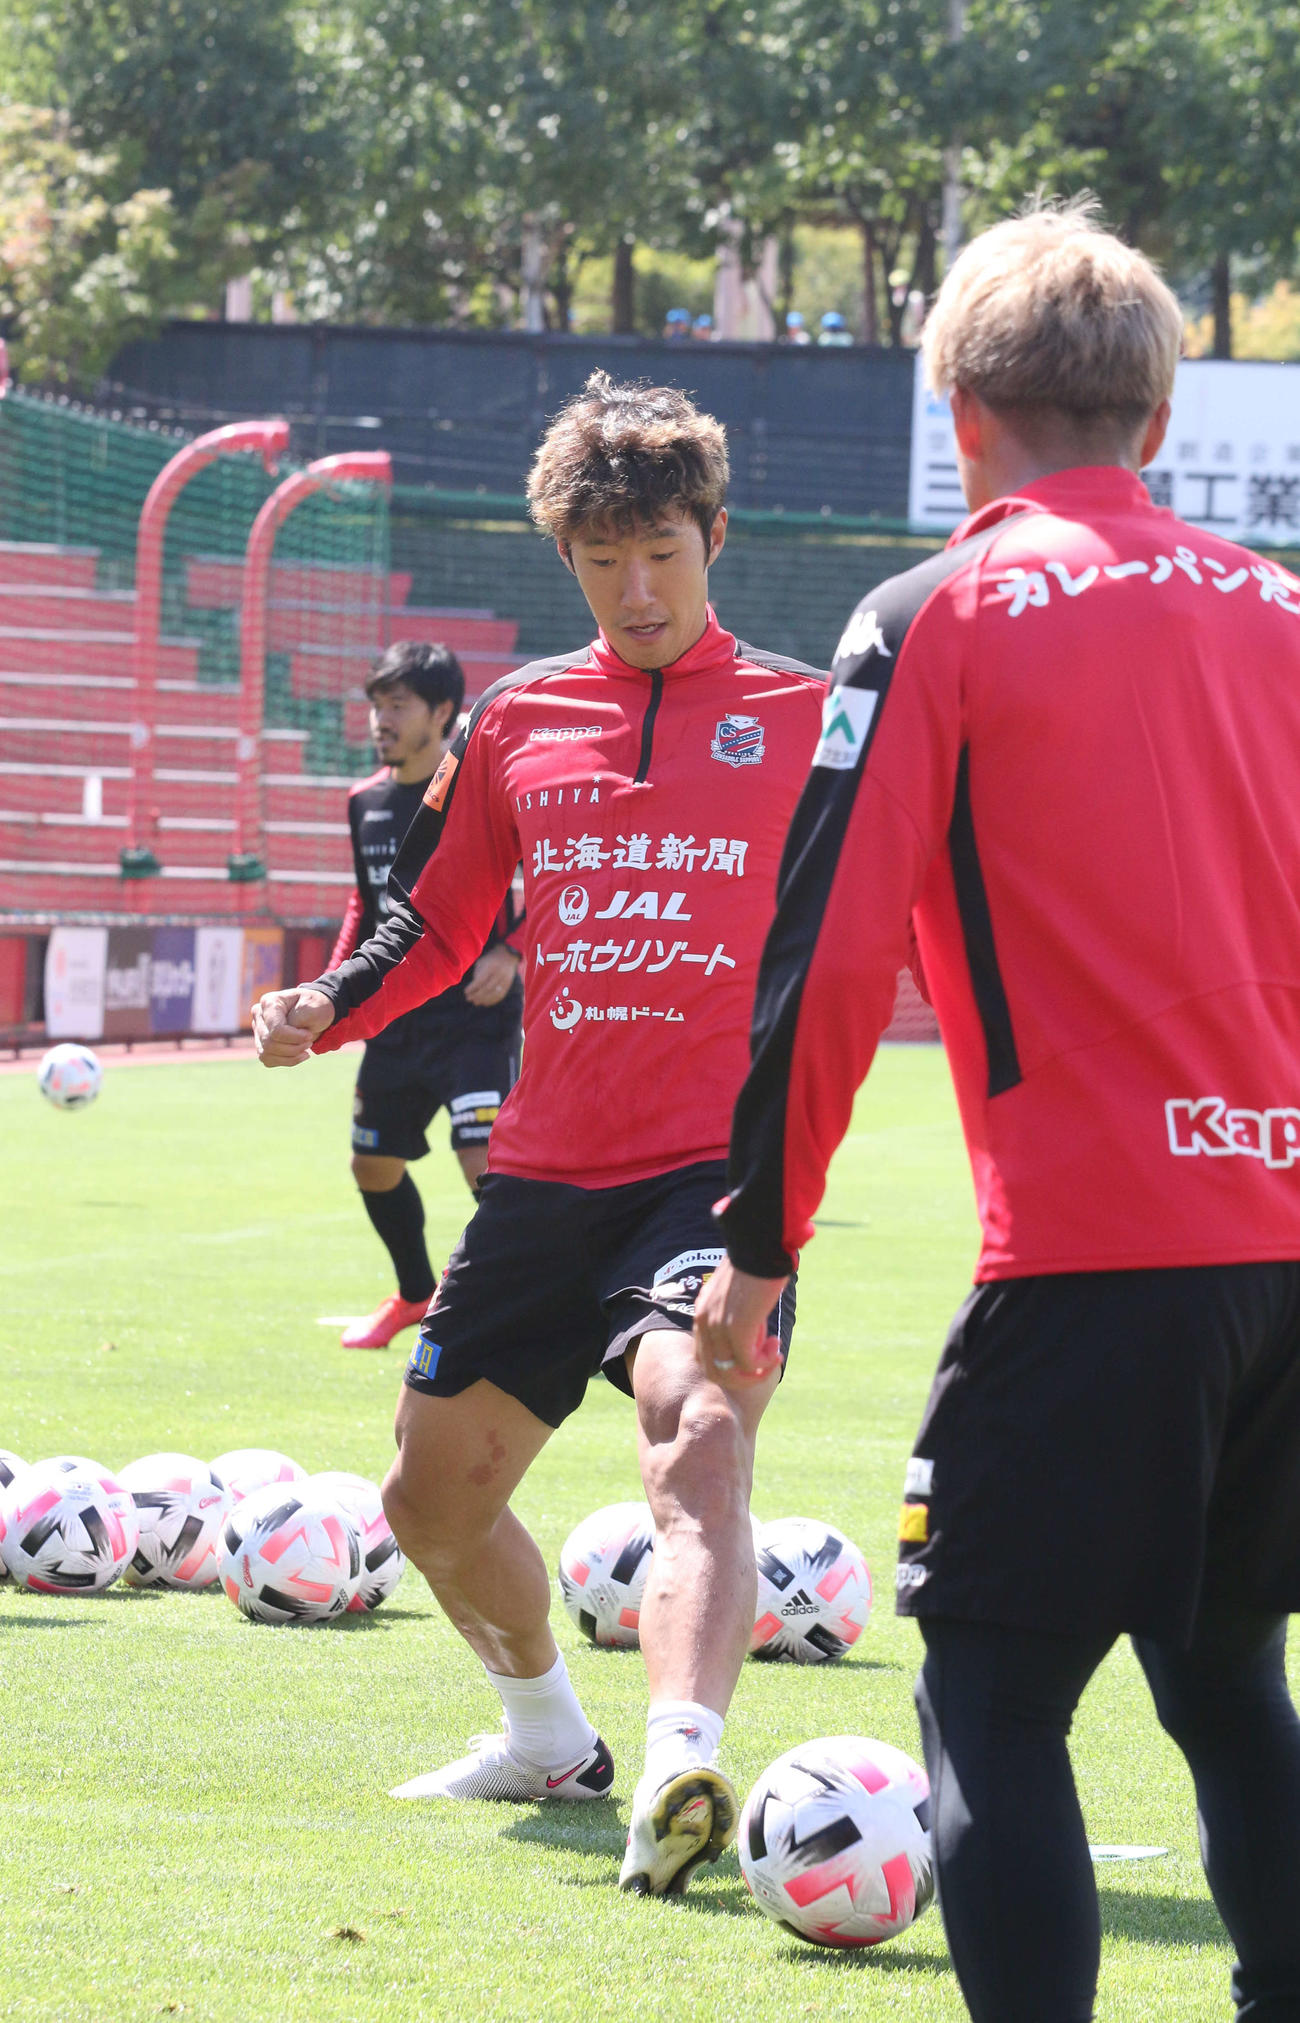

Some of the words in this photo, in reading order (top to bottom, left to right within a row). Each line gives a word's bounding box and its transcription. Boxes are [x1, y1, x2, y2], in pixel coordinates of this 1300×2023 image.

[530, 726, 602, 741] Kappa
[516, 787, 600, 812] ISHIYA
[532, 833, 749, 877] 北海道新聞
[594, 890, 693, 921] JAL
[535, 939, 736, 976] トーホウリゾート
[585, 1006, 685, 1022] 札幌ドーム
[781, 1605, 820, 1616] adidas
